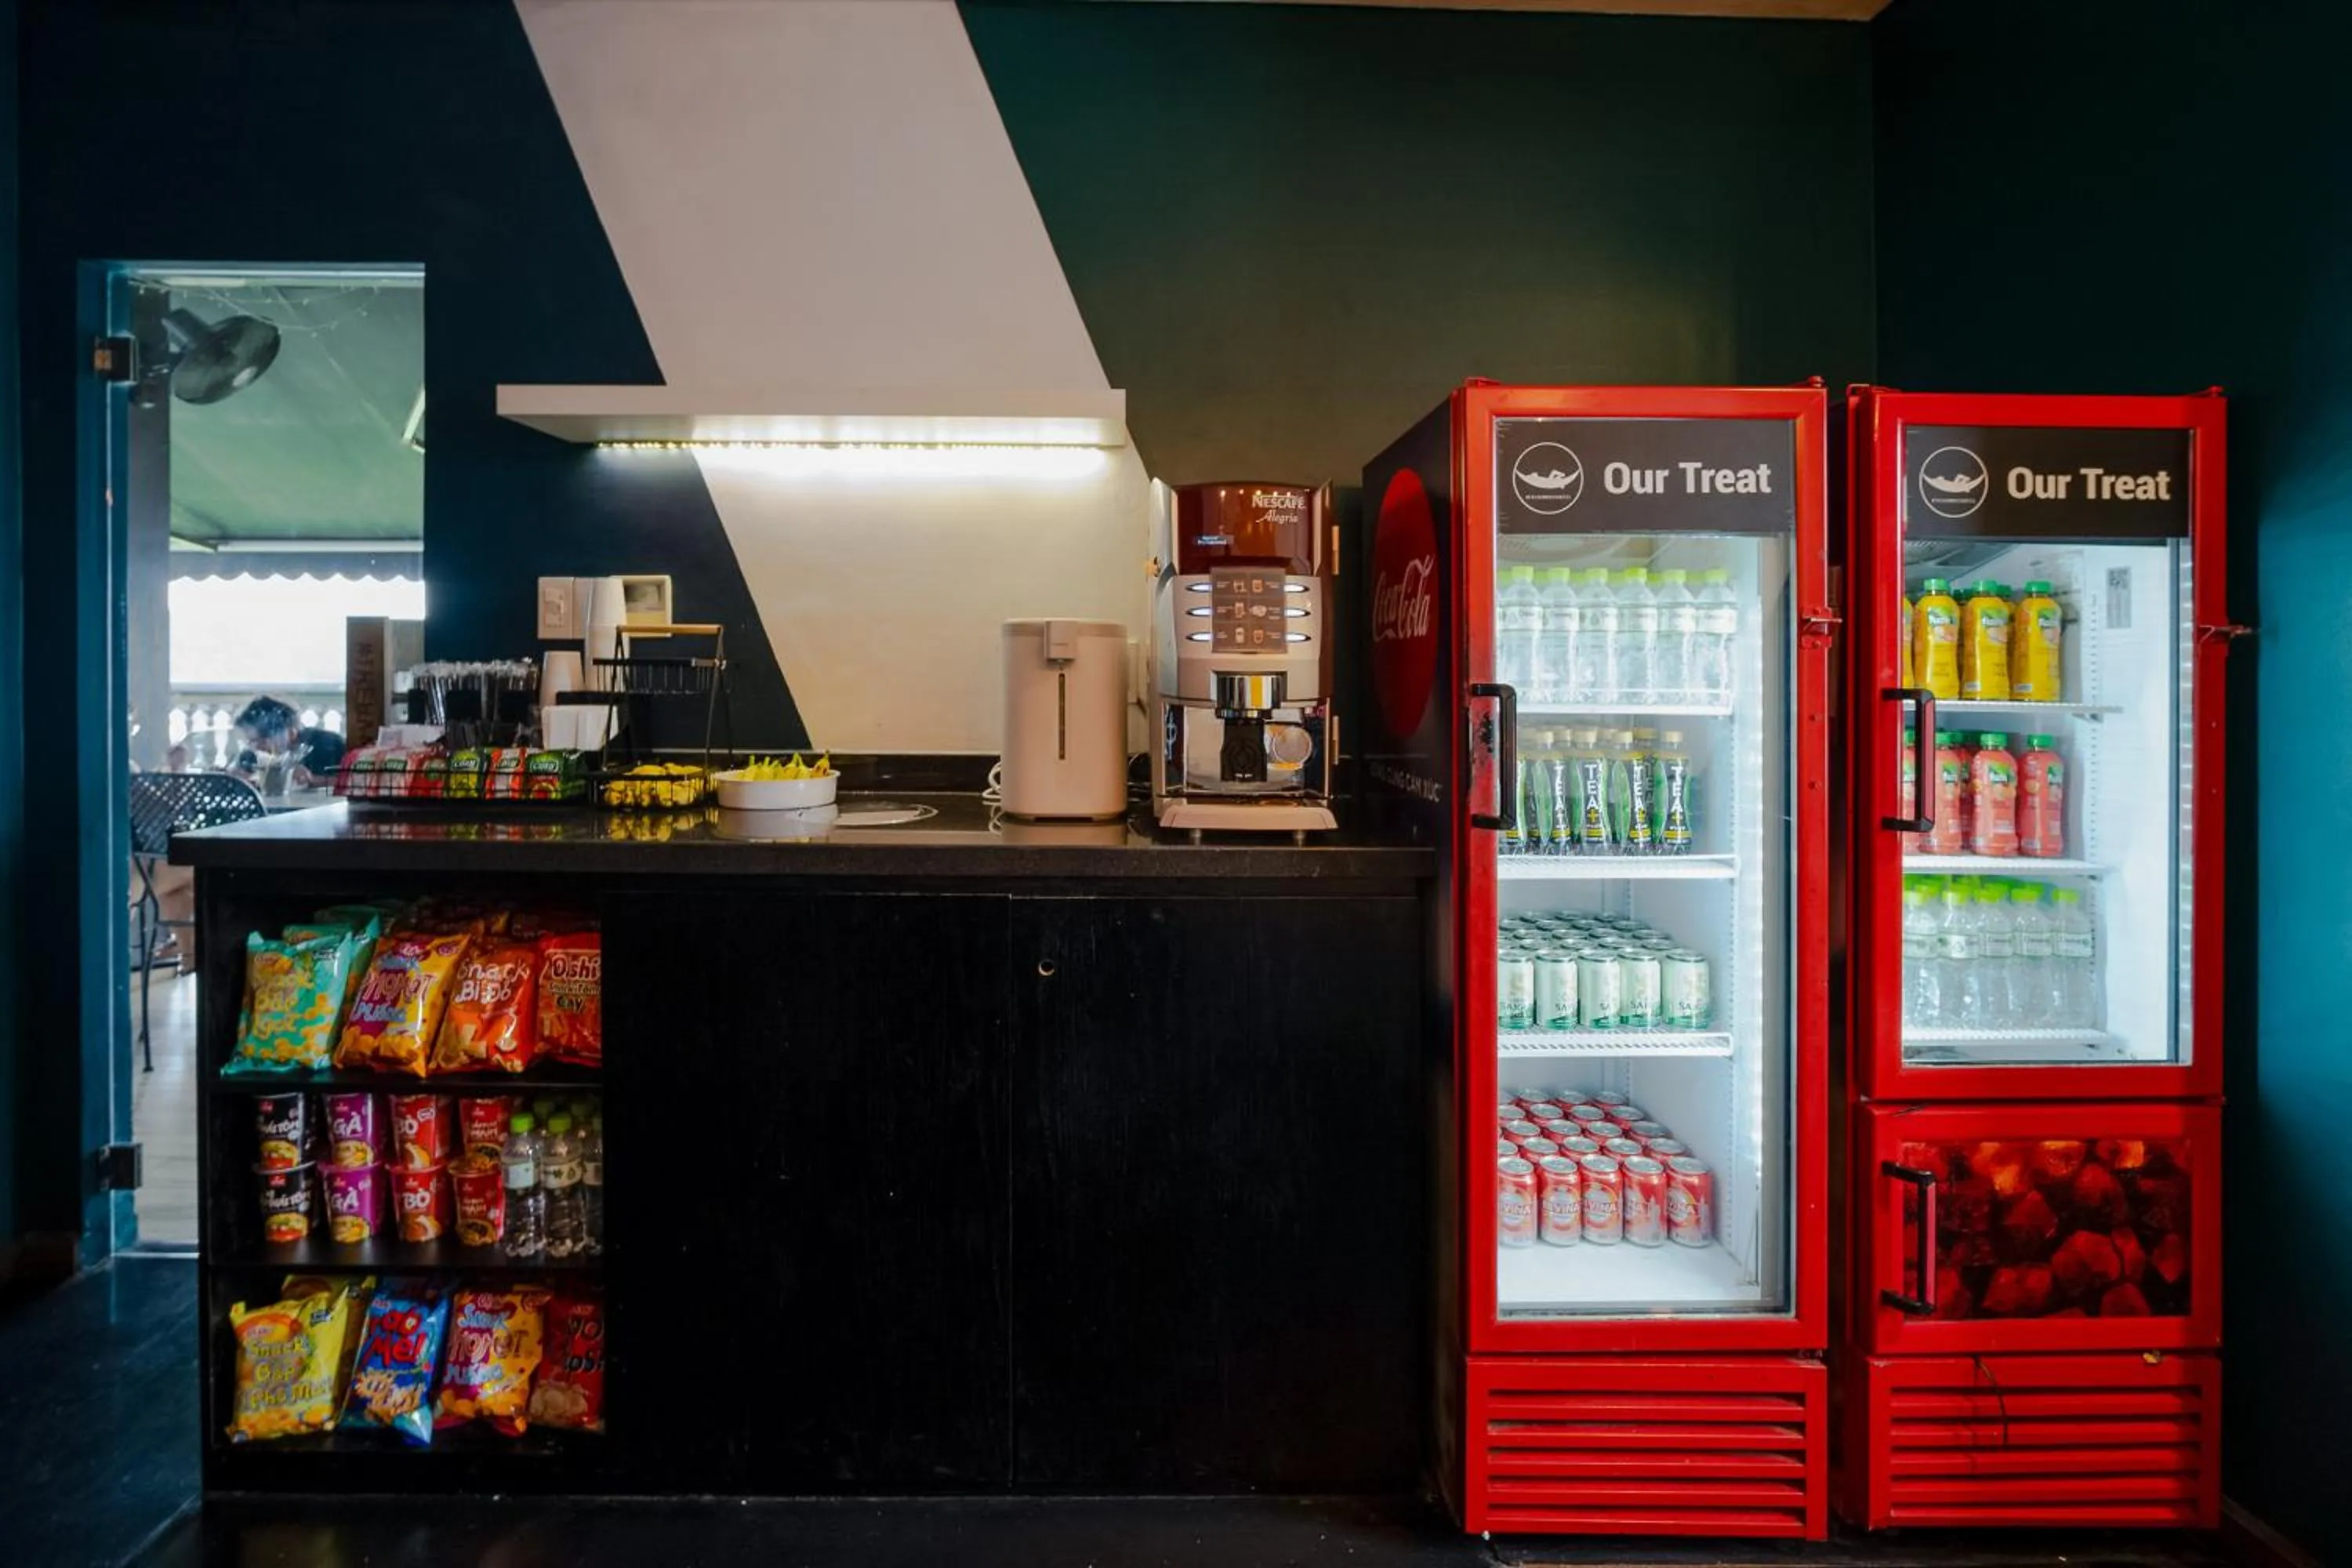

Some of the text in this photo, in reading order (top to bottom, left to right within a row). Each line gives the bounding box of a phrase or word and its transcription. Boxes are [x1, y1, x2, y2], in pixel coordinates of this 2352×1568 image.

[1604, 462, 1772, 495] Our Treat
[2007, 466, 2171, 500] Our Treat
